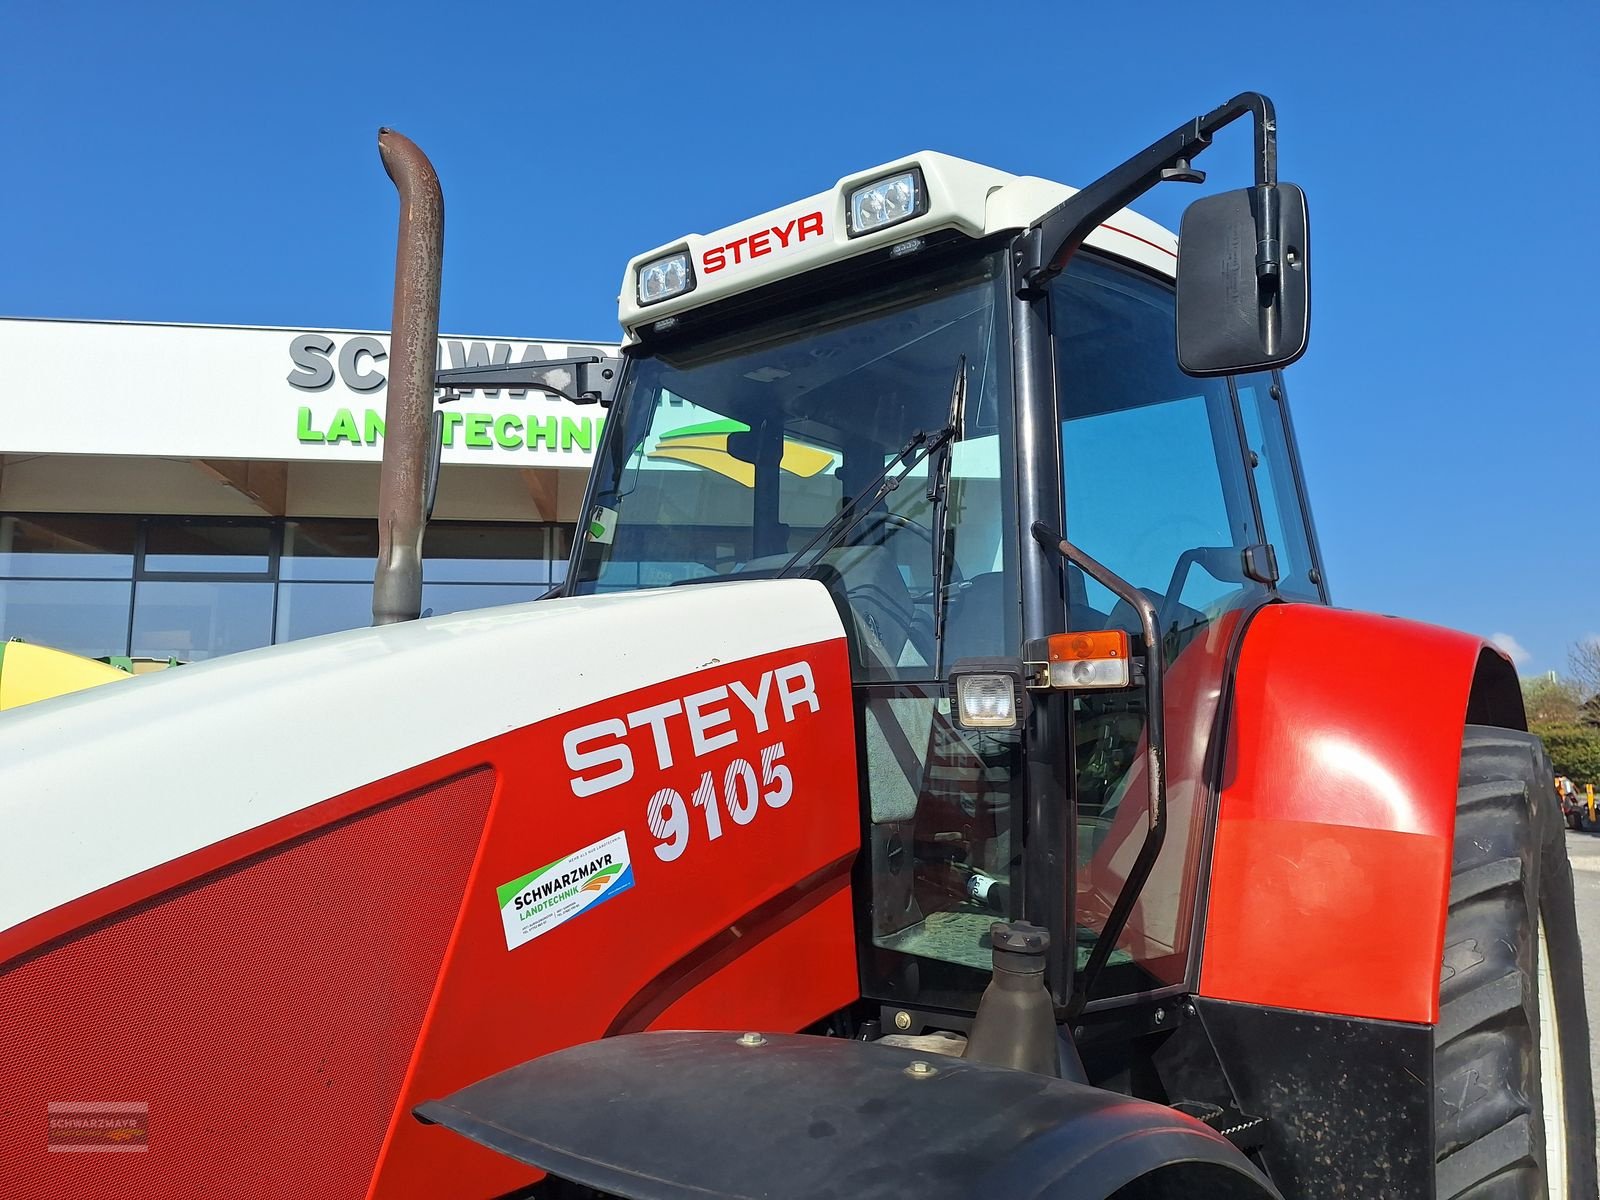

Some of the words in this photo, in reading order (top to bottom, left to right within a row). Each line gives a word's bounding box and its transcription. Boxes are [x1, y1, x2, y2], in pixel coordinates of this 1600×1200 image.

[703, 211, 824, 274] STEYR
[562, 660, 820, 798] STEYR
[646, 741, 794, 862] 9105
[514, 853, 613, 911] SCHWARZMAYR
[519, 885, 580, 922] LANDTECHNIK
